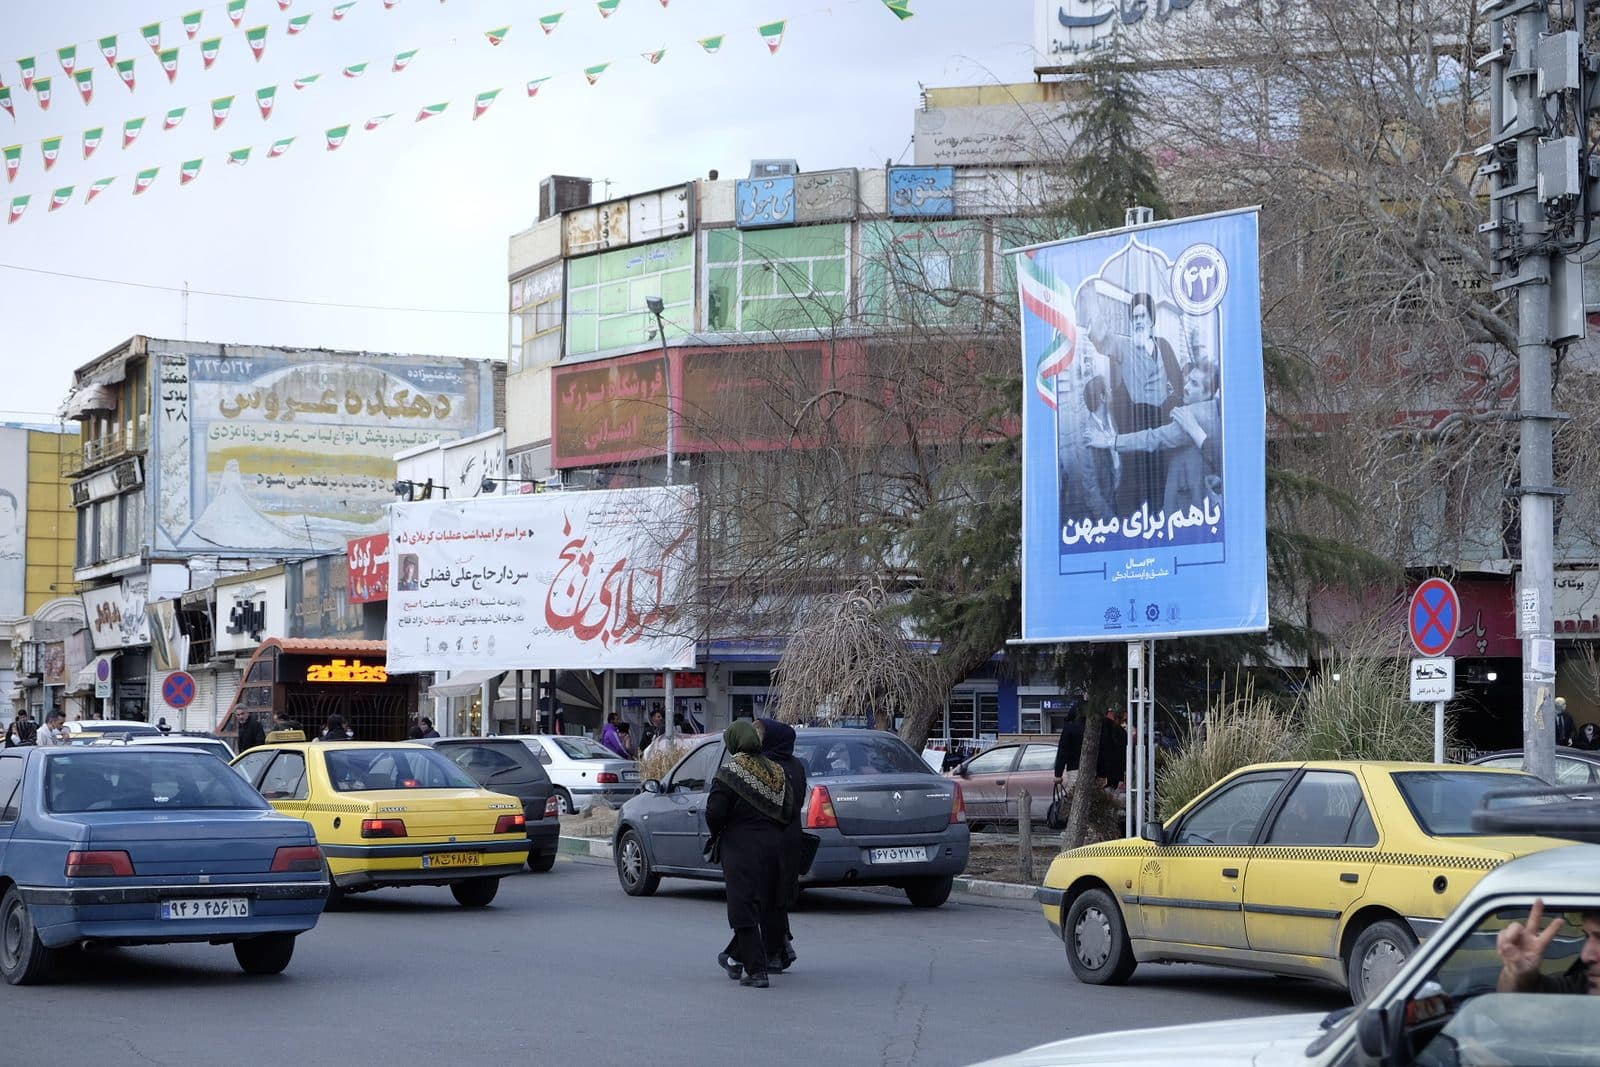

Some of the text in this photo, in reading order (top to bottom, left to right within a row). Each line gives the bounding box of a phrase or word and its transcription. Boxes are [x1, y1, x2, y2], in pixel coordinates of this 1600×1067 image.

[803, 176, 833, 190] اجرای
[1183, 264, 1216, 299] ۴۳
[162, 390, 187, 408] پلاک
[219, 388, 452, 422] دهکده عروس
[561, 382, 605, 412] بزرگ
[257, 429, 300, 443] عروس
[300, 428, 333, 444] لباس
[333, 431, 359, 446] انواع
[359, 429, 390, 449] پخش
[256, 471, 286, 489] شود
[287, 475, 307, 490] می
[1122, 500, 1165, 540] برای
[402, 527, 527, 546] مراسم گرامیداشت عملیات کربلای ۵
[1061, 515, 1120, 545] میهن
[349, 540, 371, 576] کودک
[419, 564, 529, 590] سردار حاج علی فضلی
[1558, 580, 1585, 591] پوشاک
[480, 597, 496, 608] شنبه
[477, 613, 492, 625] شهید
[306, 659, 388, 683] adidas
[171, 903, 187, 916] ۹۴
[204, 901, 229, 916] ۴۵۶
[233, 903, 247, 915] ۱۵
